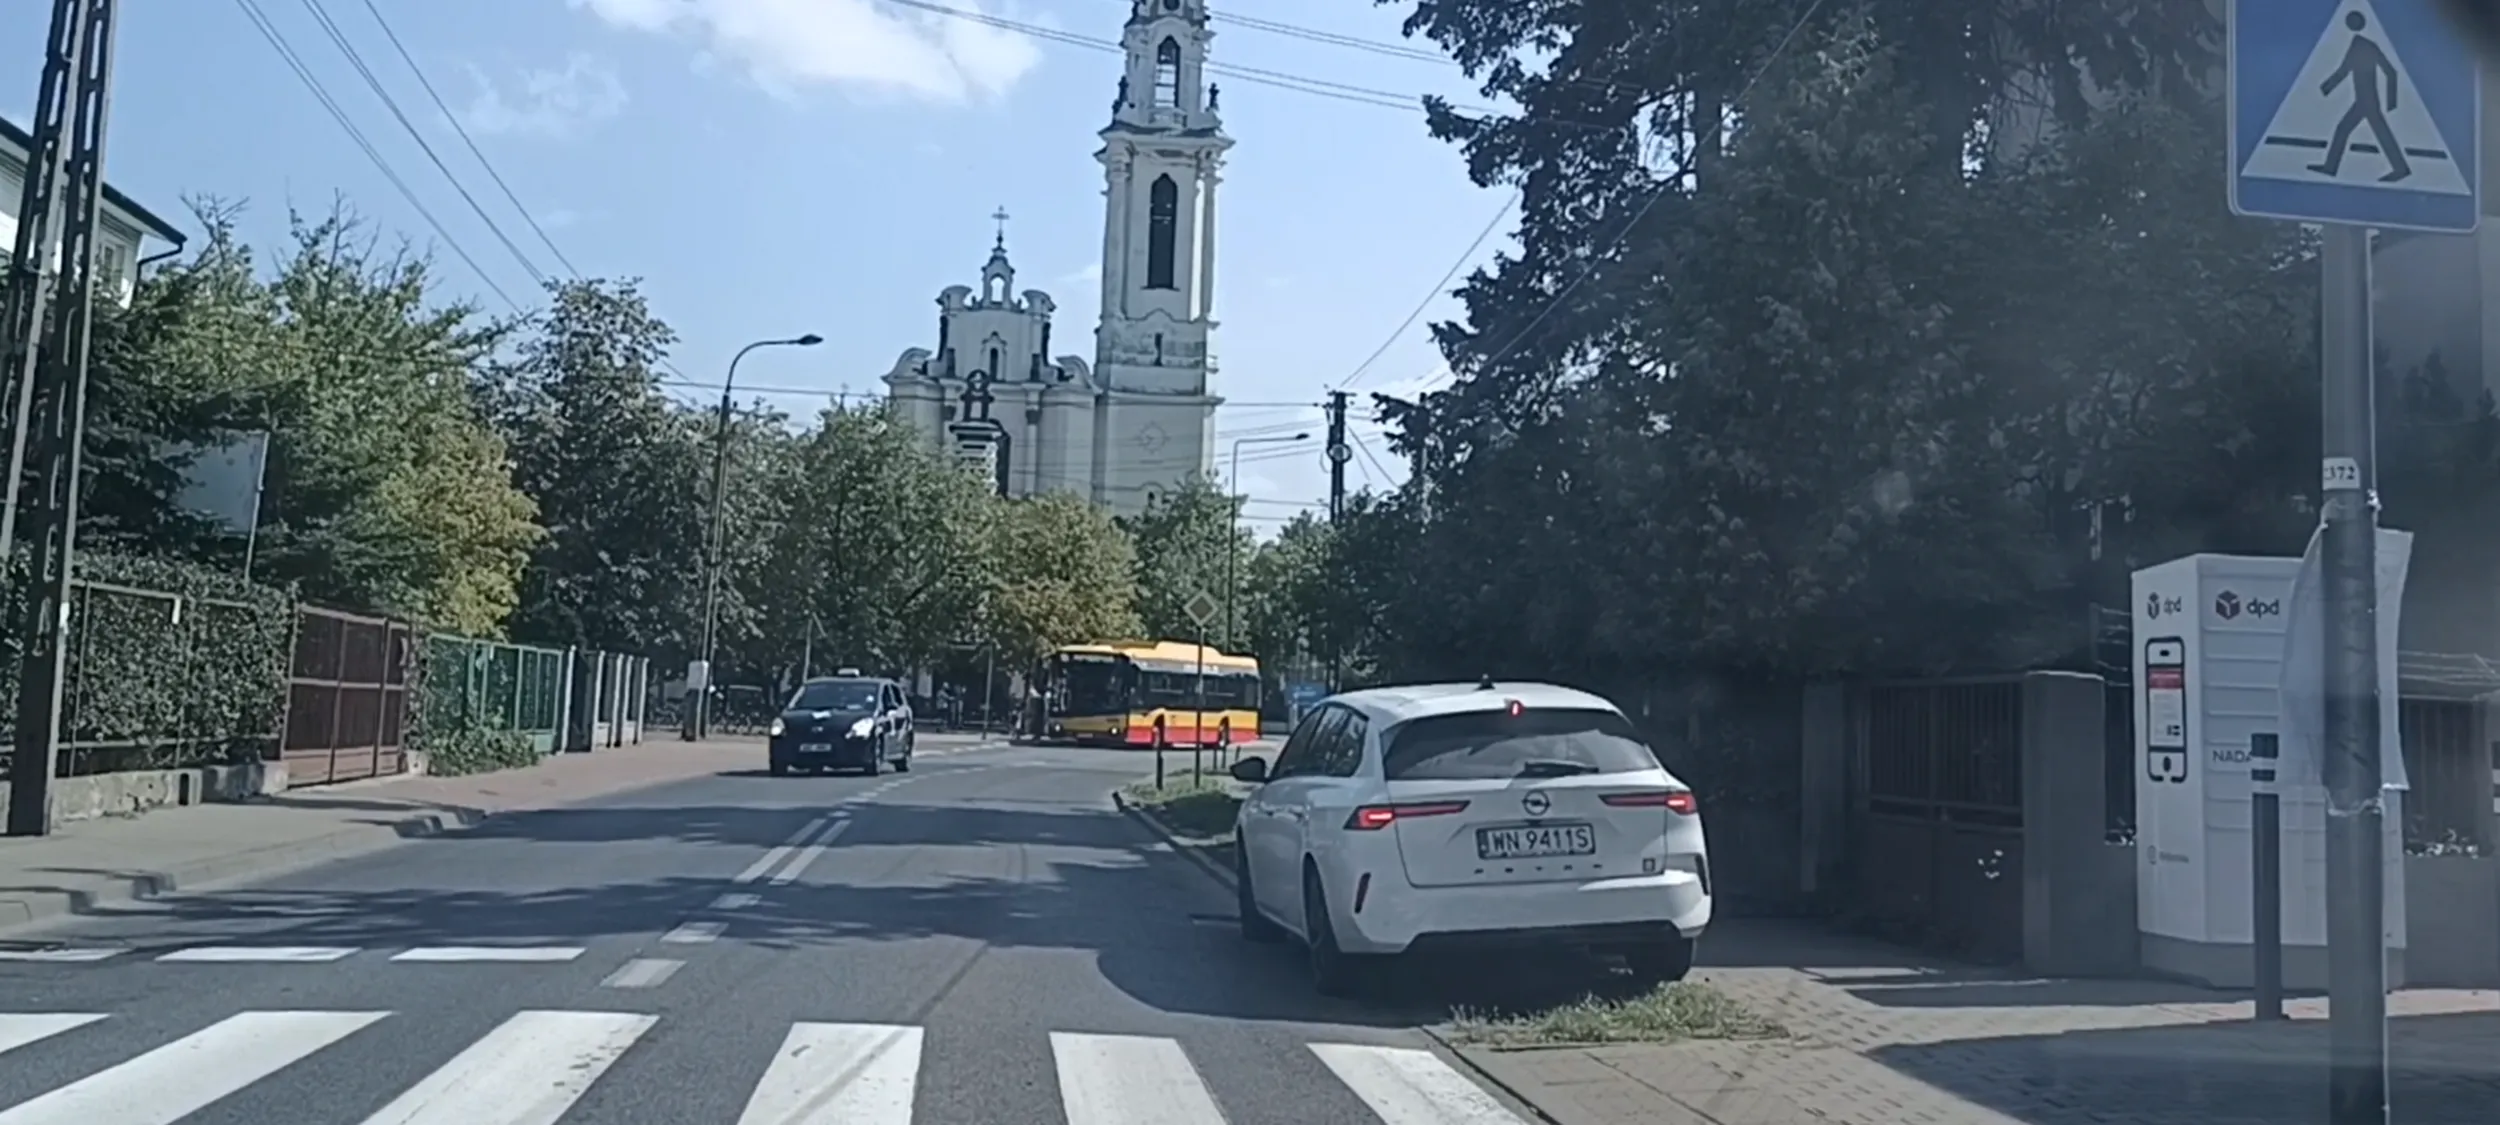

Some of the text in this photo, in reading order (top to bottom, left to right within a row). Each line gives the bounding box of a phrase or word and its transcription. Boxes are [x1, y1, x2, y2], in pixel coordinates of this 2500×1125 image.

[2246, 597, 2280, 620] dpd
[1492, 828, 1589, 851] WN 9411S
